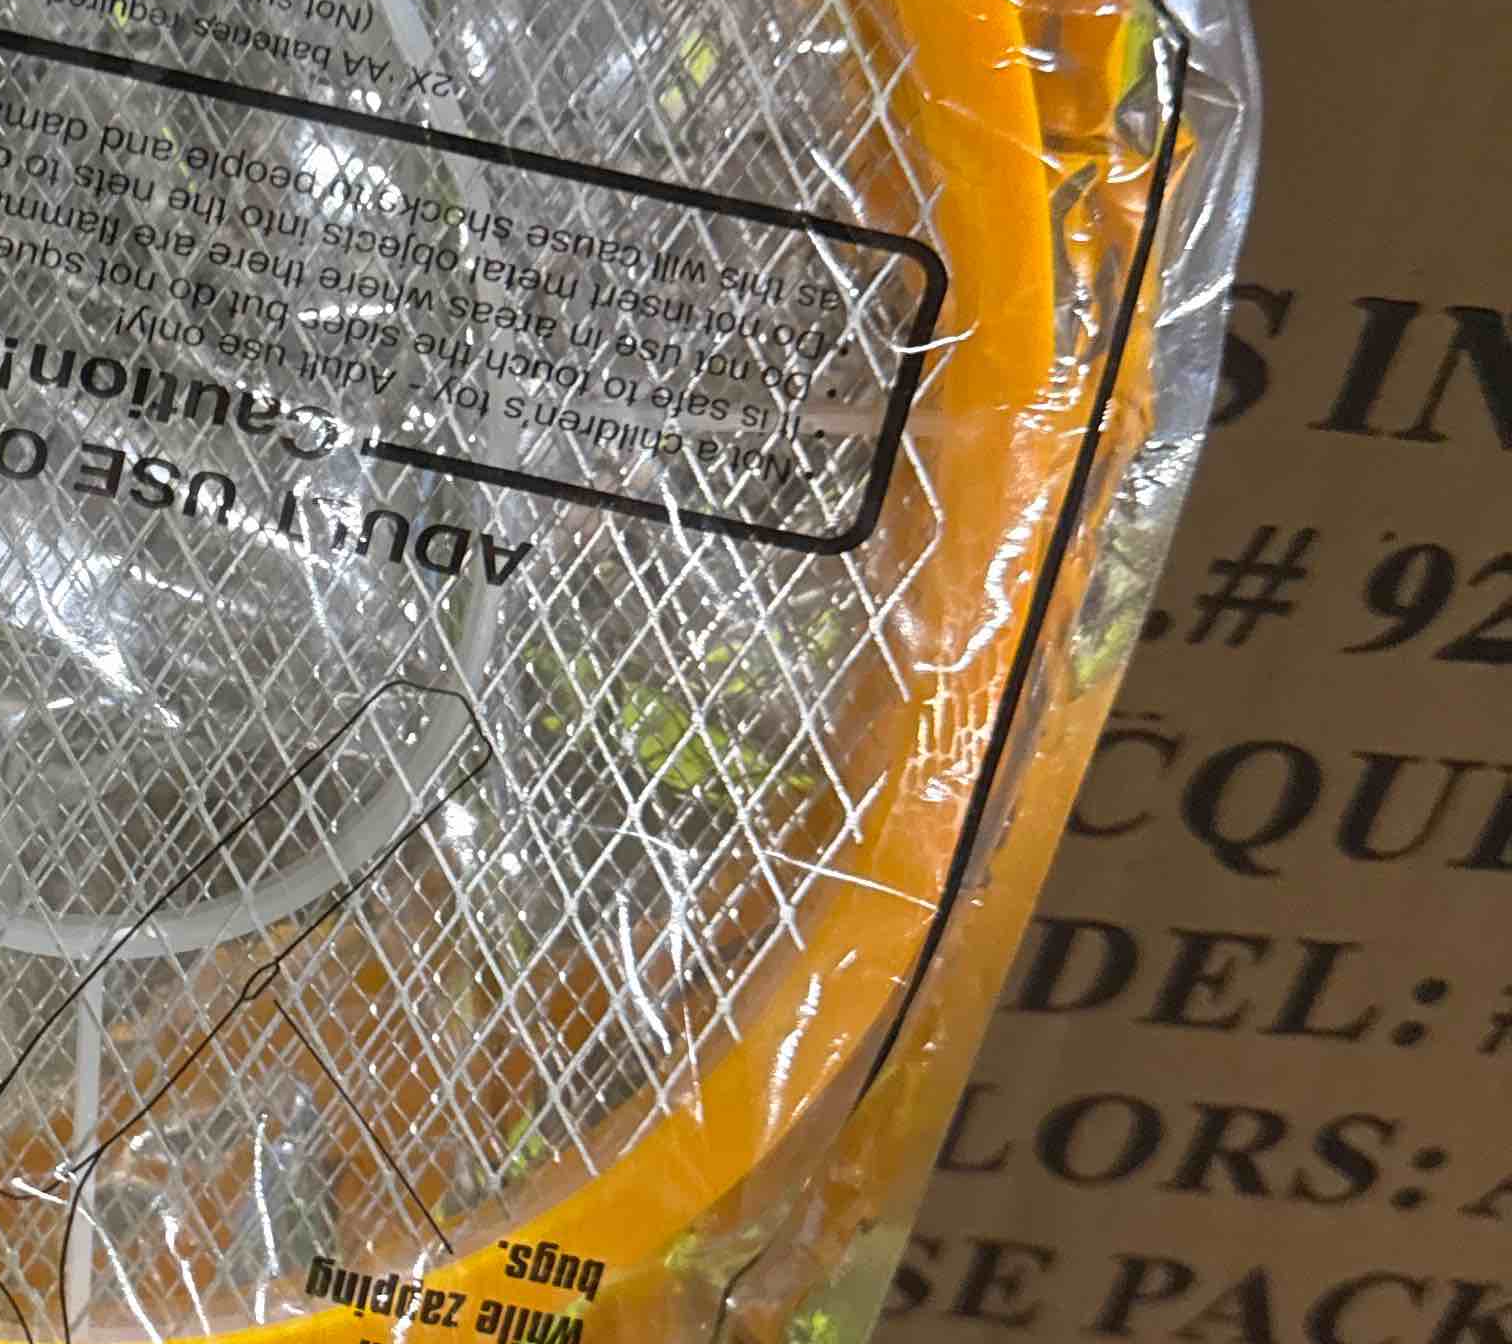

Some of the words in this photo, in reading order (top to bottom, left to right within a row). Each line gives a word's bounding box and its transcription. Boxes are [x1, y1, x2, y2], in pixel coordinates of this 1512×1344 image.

[189, 13, 331, 71] batteries
[21, 151, 60, 183] to
[97, 124, 173, 168] and
[184, 134, 319, 199] people
[69, 161, 155, 206] nets
[164, 184, 229, 225] the
[129, 222, 195, 260] are
[237, 201, 310, 244] into
[205, 239, 306, 288] there
[317, 214, 462, 279] objects
[524, 222, 643, 270] cause
[94, 258, 155, 296] not
[468, 255, 579, 306] metal
[653, 250, 708, 289] will
[717, 265, 786, 307] this
[166, 275, 218, 311] do
[227, 288, 289, 327] but
[316, 264, 436, 318] where
[590, 283, 695, 330] insert
[794, 281, 842, 314] as
[112, 300, 208, 355] only!
[445, 293, 558, 343] areas
[568, 322, 604, 354] in
[703, 308, 760, 342] not
[216, 332, 286, 369] use
[411, 330, 472, 369] the
[615, 330, 682, 366] use
[770, 321, 826, 358] Do
[294, 349, 395, 397] Adult
[484, 346, 589, 395] touch
[692, 349, 743, 383] not
[759, 361, 812, 399] Do
[430, 373, 493, 415] toy
[601, 374, 639, 405] to
[648, 383, 732, 426] safe
[500, 393, 685, 462] children's
[739, 402, 769, 433] is
[778, 410, 803, 440] It
[694, 437, 719, 464] a
[722, 441, 795, 485] Not
[71, 440, 238, 525] USE
[491, 1235, 607, 1303] bugs.
[301, 1254, 469, 1332] zapping
